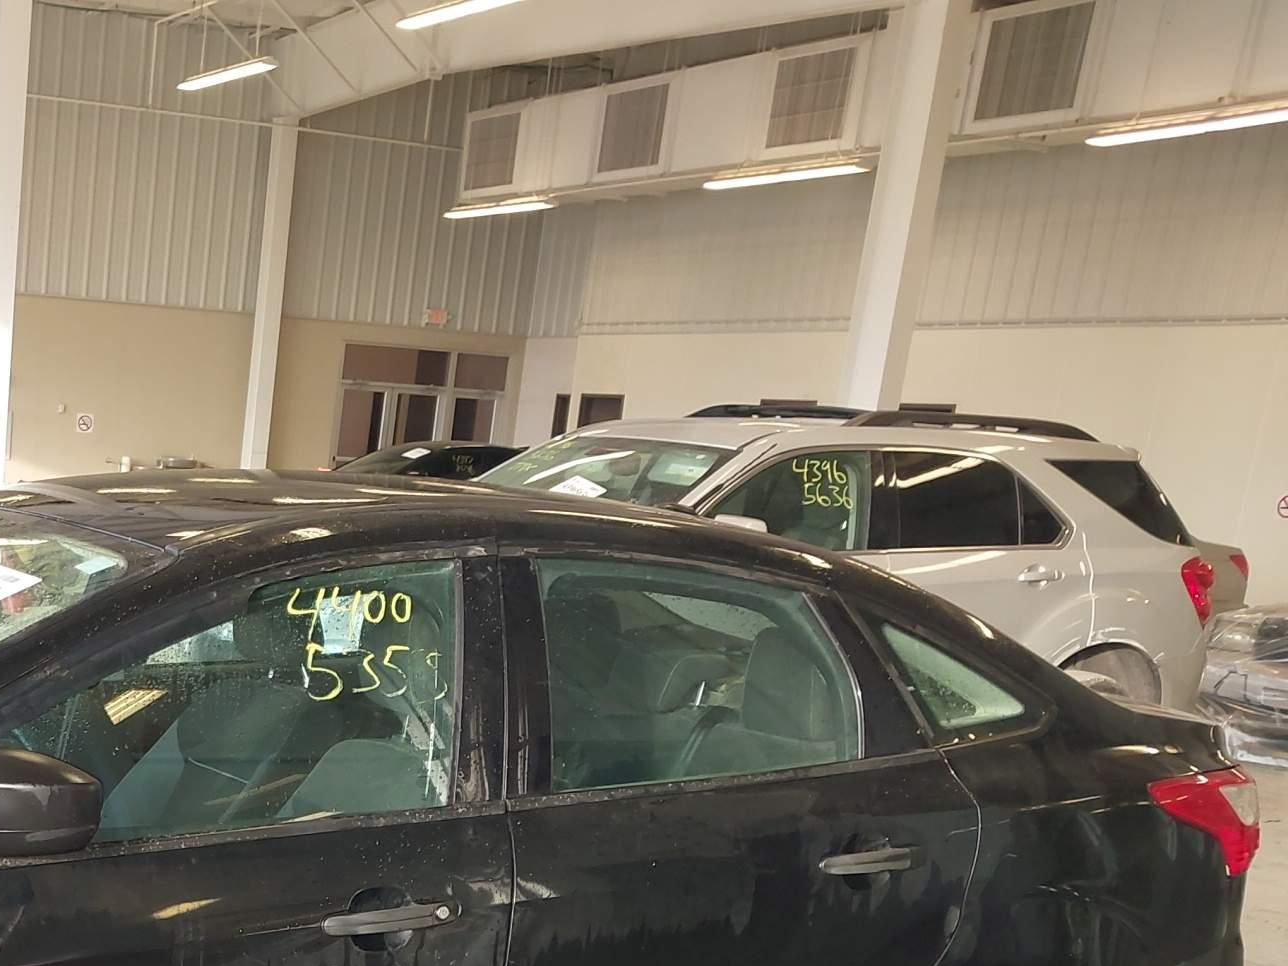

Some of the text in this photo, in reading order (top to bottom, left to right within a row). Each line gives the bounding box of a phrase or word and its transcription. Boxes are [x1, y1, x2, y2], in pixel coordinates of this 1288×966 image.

[792, 459, 847, 484] 4396
[801, 483, 853, 509] 5636
[286, 586, 412, 642] 4400
